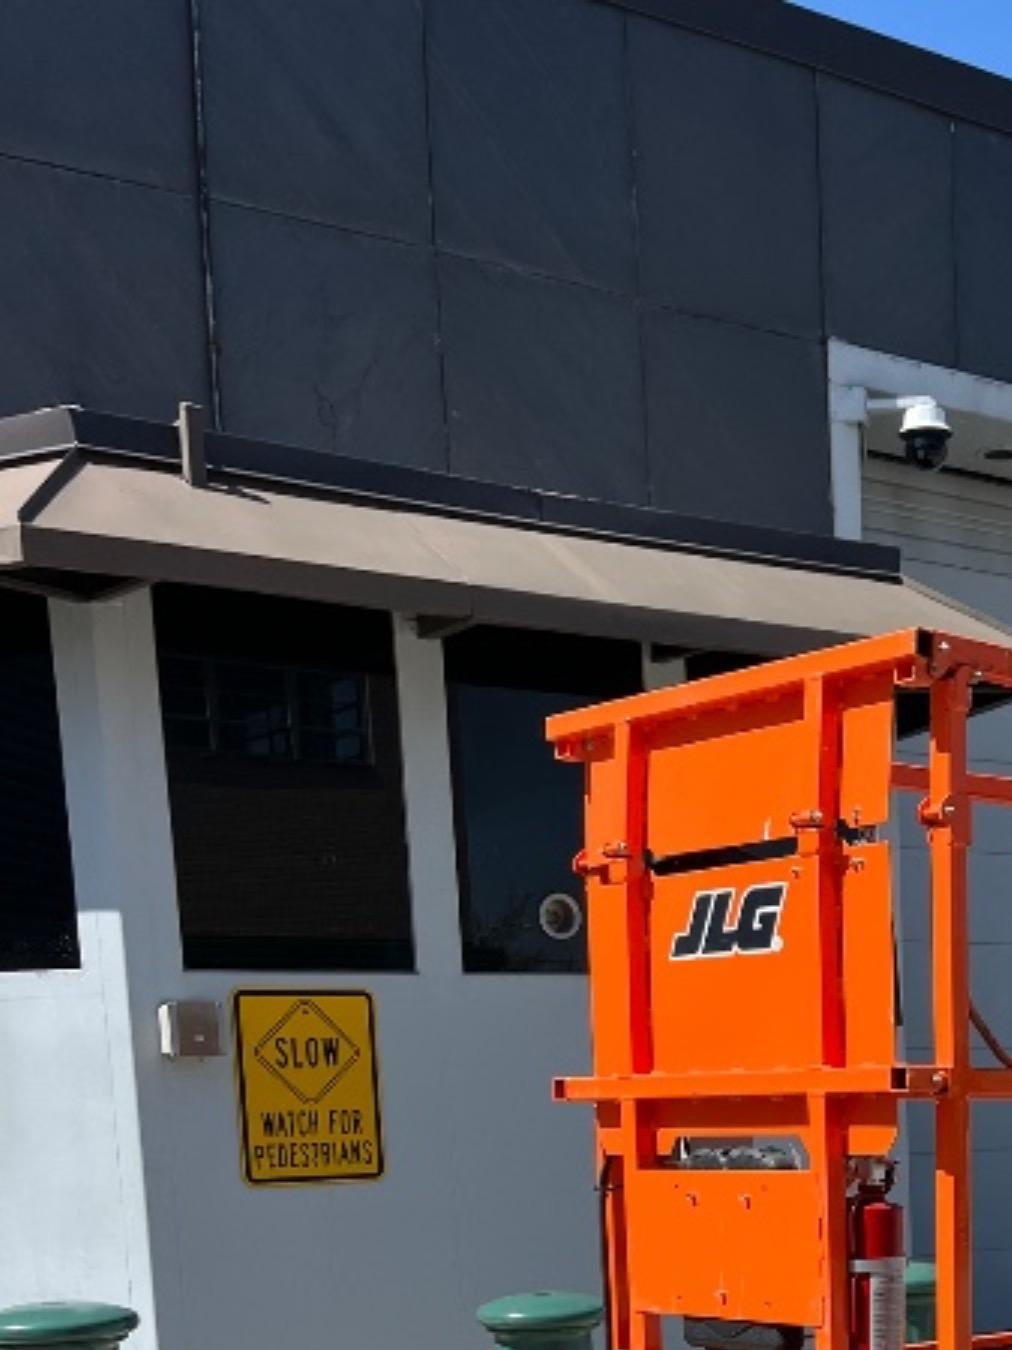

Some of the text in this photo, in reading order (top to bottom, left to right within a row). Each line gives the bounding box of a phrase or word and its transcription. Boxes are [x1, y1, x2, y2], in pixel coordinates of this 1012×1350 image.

[669, 882, 788, 960] JLG
[274, 1037, 340, 1069] SLOW
[260, 1109, 364, 1138] WATCH FOR
[253, 1140, 374, 1170] PEDESTRIANS
